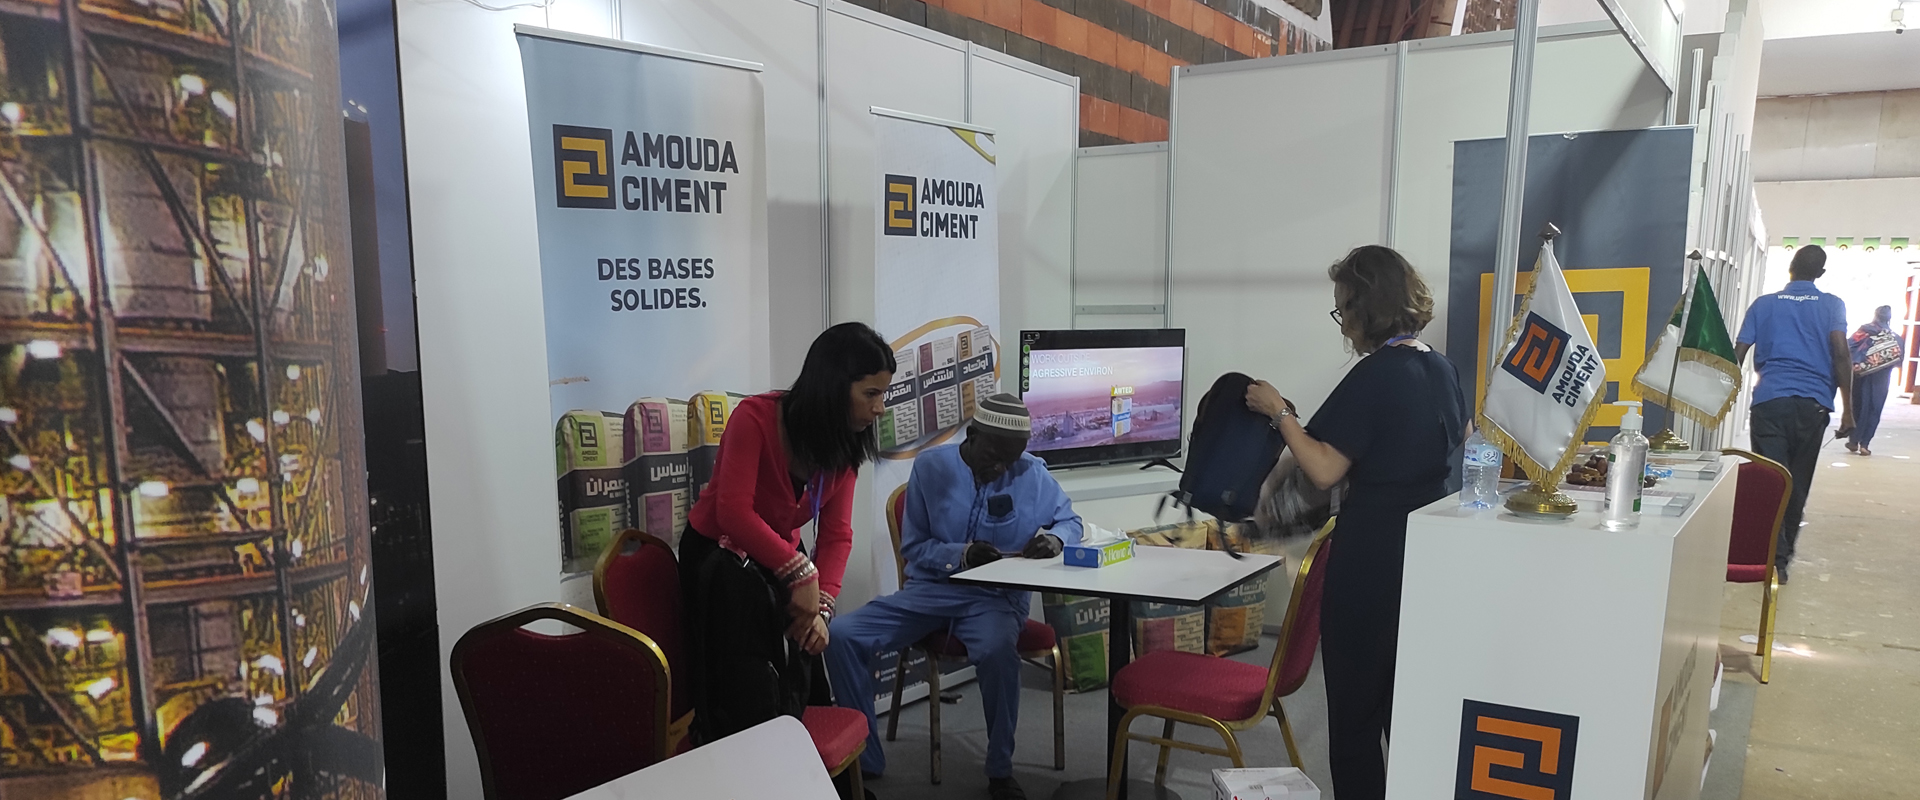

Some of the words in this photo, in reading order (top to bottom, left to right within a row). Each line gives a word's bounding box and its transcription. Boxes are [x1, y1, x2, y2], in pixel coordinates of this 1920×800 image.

[621, 131, 739, 174] AMOUDA
[621, 176, 727, 214] CIMENT
[920, 178, 984, 209] AMOUDA
[920, 211, 978, 239] CIMENT
[598, 258, 641, 281] DES
[648, 257, 714, 280] BASES
[611, 288, 707, 312] SOLIDES.
[1031, 354, 1057, 365] WORK
[1057, 352, 1091, 363] OUTSDE
[1032, 367, 1077, 378] AGRESSIVE
[1080, 366, 1113, 377] ENVIRON
[1551, 344, 1589, 404] AMOUDA
[1564, 354, 1600, 408] CIMENT
